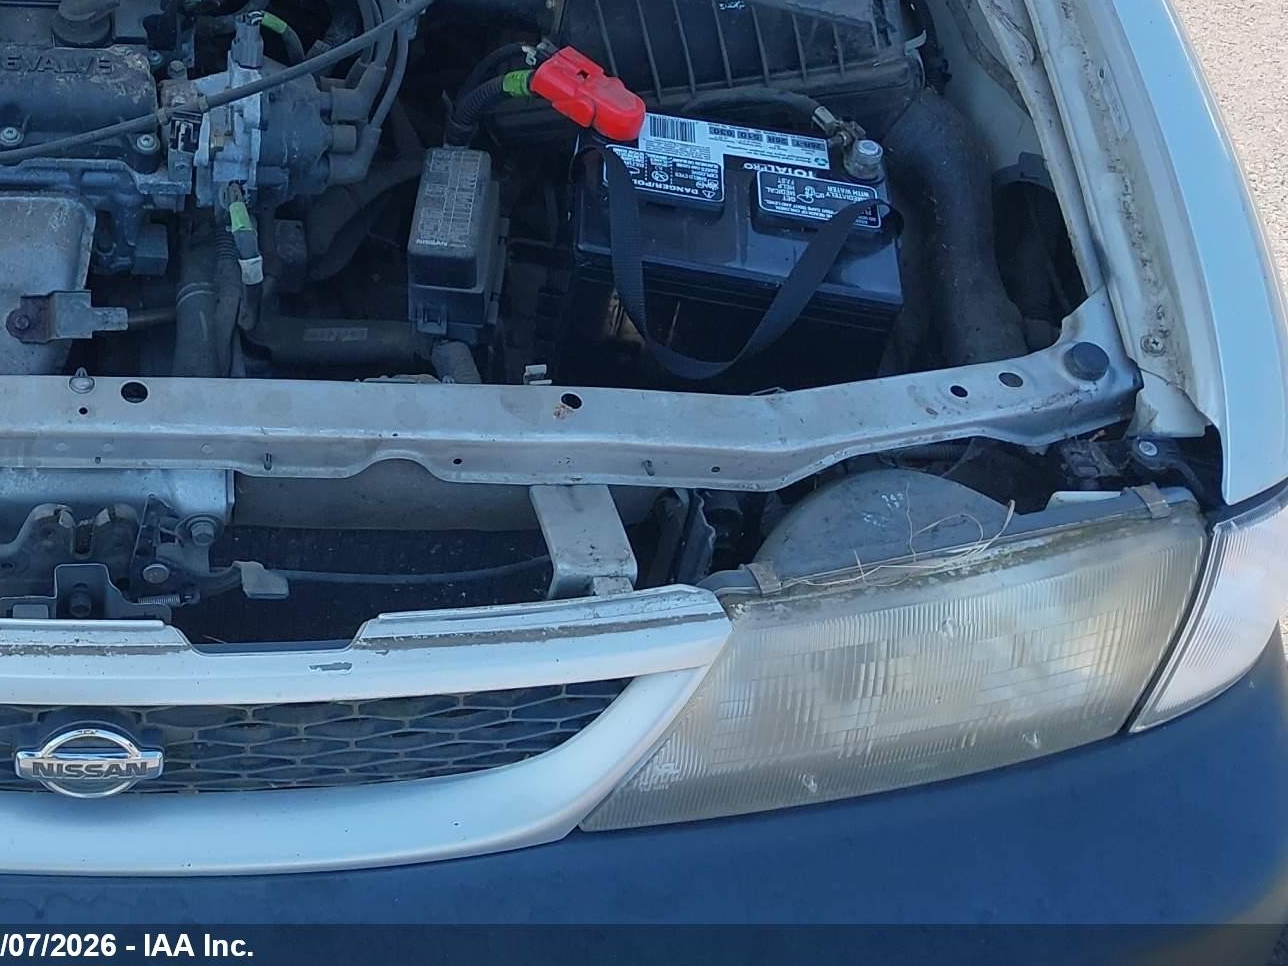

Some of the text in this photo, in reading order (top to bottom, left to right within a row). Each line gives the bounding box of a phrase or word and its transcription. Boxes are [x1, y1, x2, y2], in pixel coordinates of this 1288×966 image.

[743, 162, 816, 179] TOTALPRO
[764, 186, 796, 198] MEDICAL
[783, 195, 797, 203] GET
[31, 761, 148, 778] NISSAN
